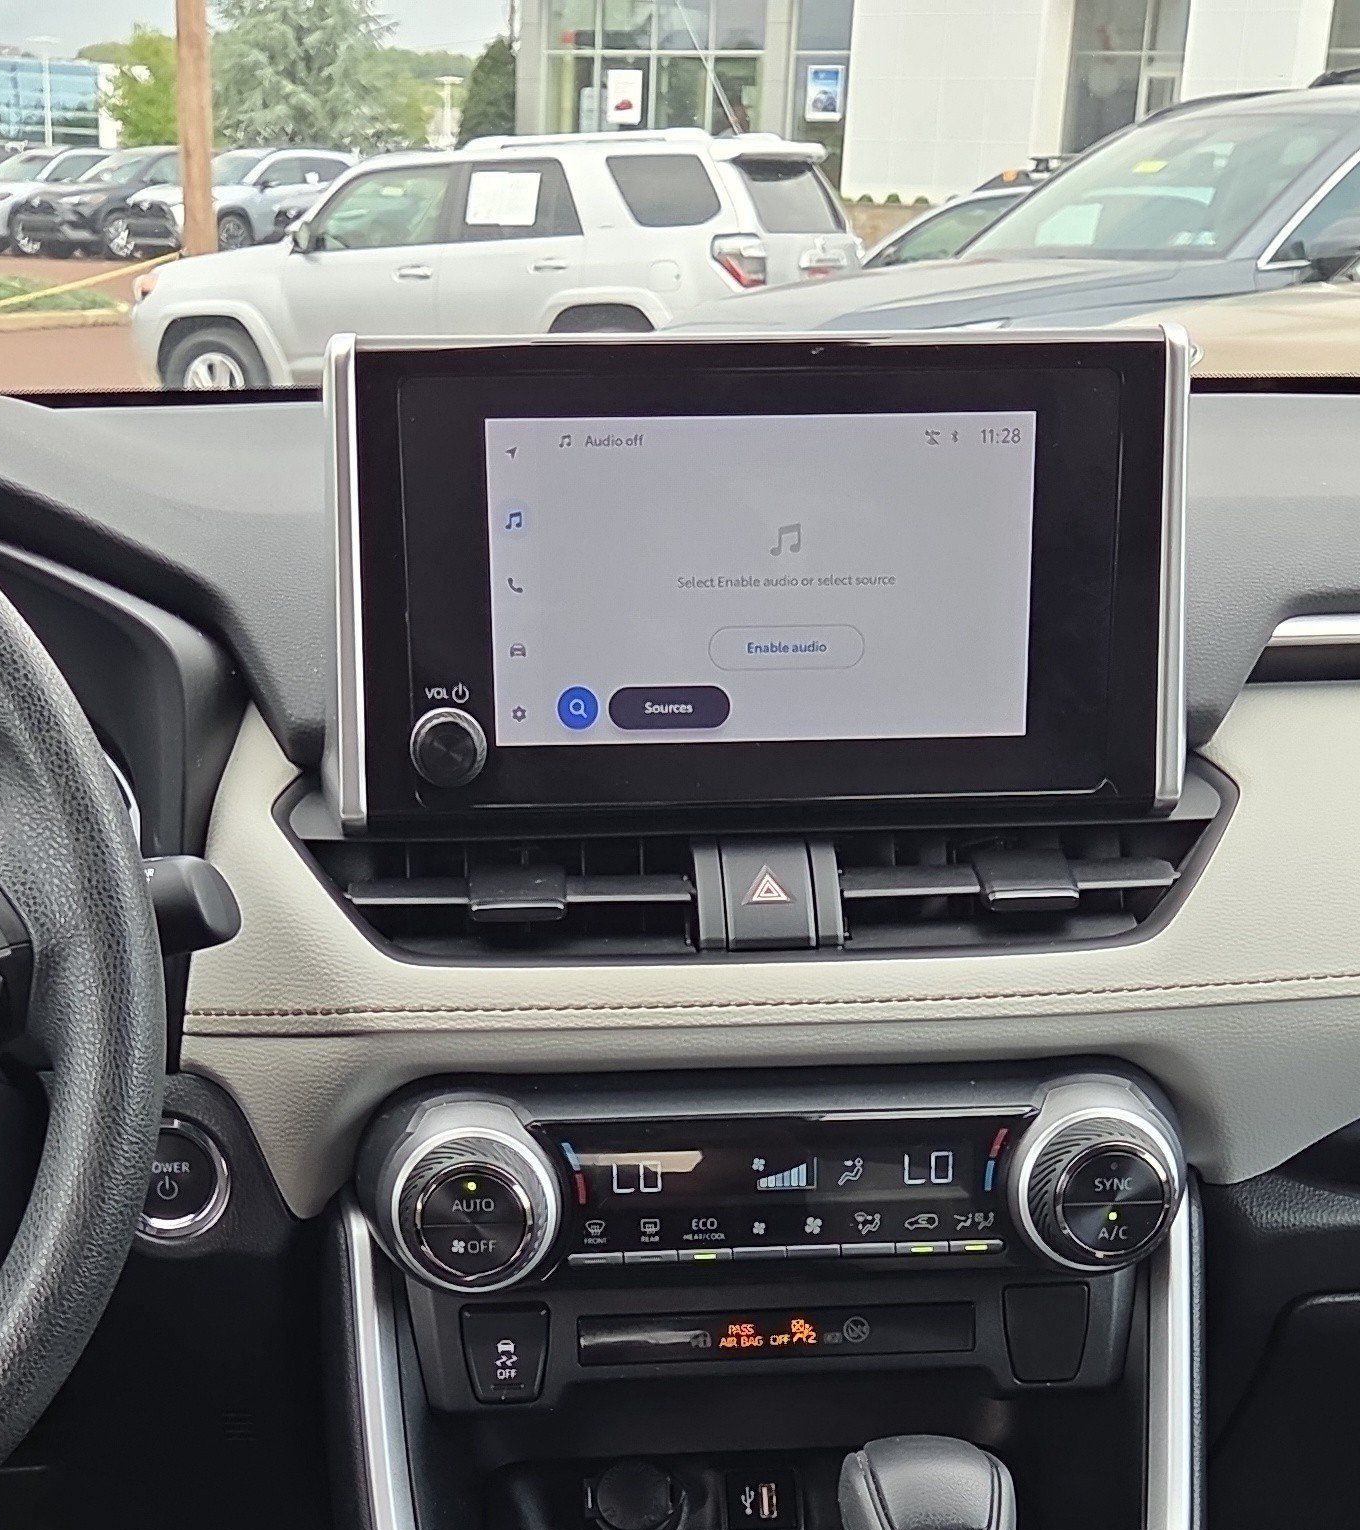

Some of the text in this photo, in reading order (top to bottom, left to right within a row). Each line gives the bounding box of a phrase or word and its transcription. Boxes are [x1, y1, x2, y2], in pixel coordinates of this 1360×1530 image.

[585, 433, 644, 447] Audio off
[981, 427, 1021, 444] 11:28
[677, 573, 896, 589] Select Enable audio or select source
[747, 640, 827, 653] Enable audio
[425, 687, 449, 700] VOL
[644, 701, 693, 714] Sources
[151, 1161, 190, 1174] OWER
[903, 1151, 953, 1185] LO
[1094, 1177, 1133, 1192] SYNC
[452, 1198, 495, 1213] AUTO
[691, 1218, 718, 1231] ECO
[1097, 1225, 1129, 1240] A/C
[467, 1240, 497, 1254] OFF
[727, 1323, 755, 1336] PASS
[718, 1336, 738, 1349] AIR
[740, 1335, 764, 1348] BAG
[769, 1334, 790, 1346] OFF
[497, 1369, 517, 1380] OFF
